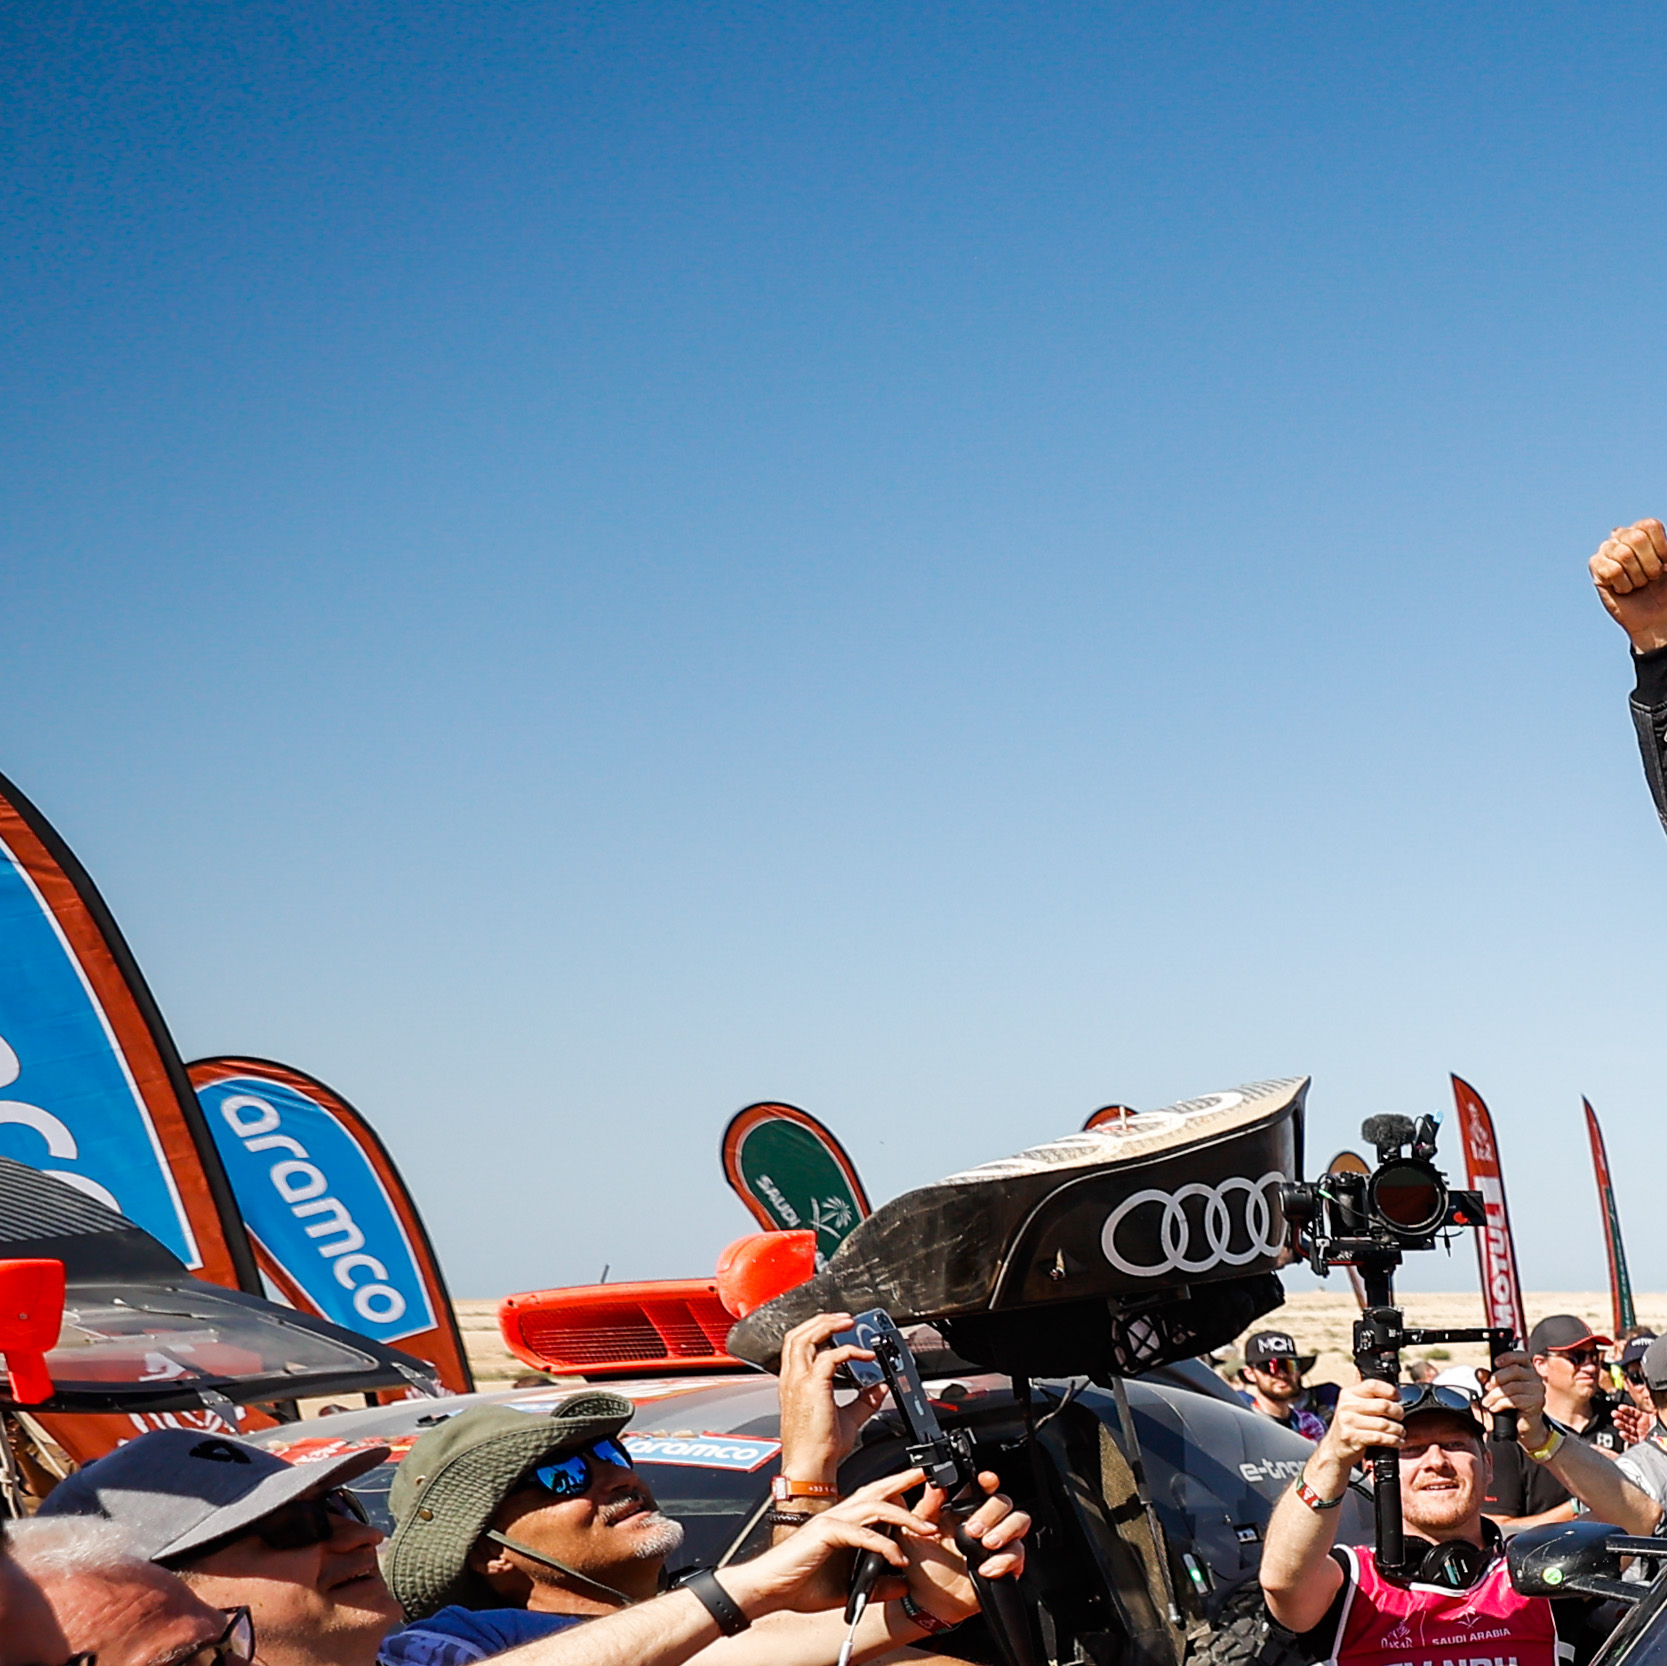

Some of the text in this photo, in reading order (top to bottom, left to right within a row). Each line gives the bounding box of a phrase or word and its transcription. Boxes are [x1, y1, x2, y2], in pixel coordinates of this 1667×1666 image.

[221, 1094, 406, 1323] aramco
[755, 1174, 802, 1228] SAUDI
[1485, 1209, 1514, 1328] MOTUL
[626, 1440, 759, 1460] aramco
[1432, 1627, 1511, 1646] SAUDI ARABIA
